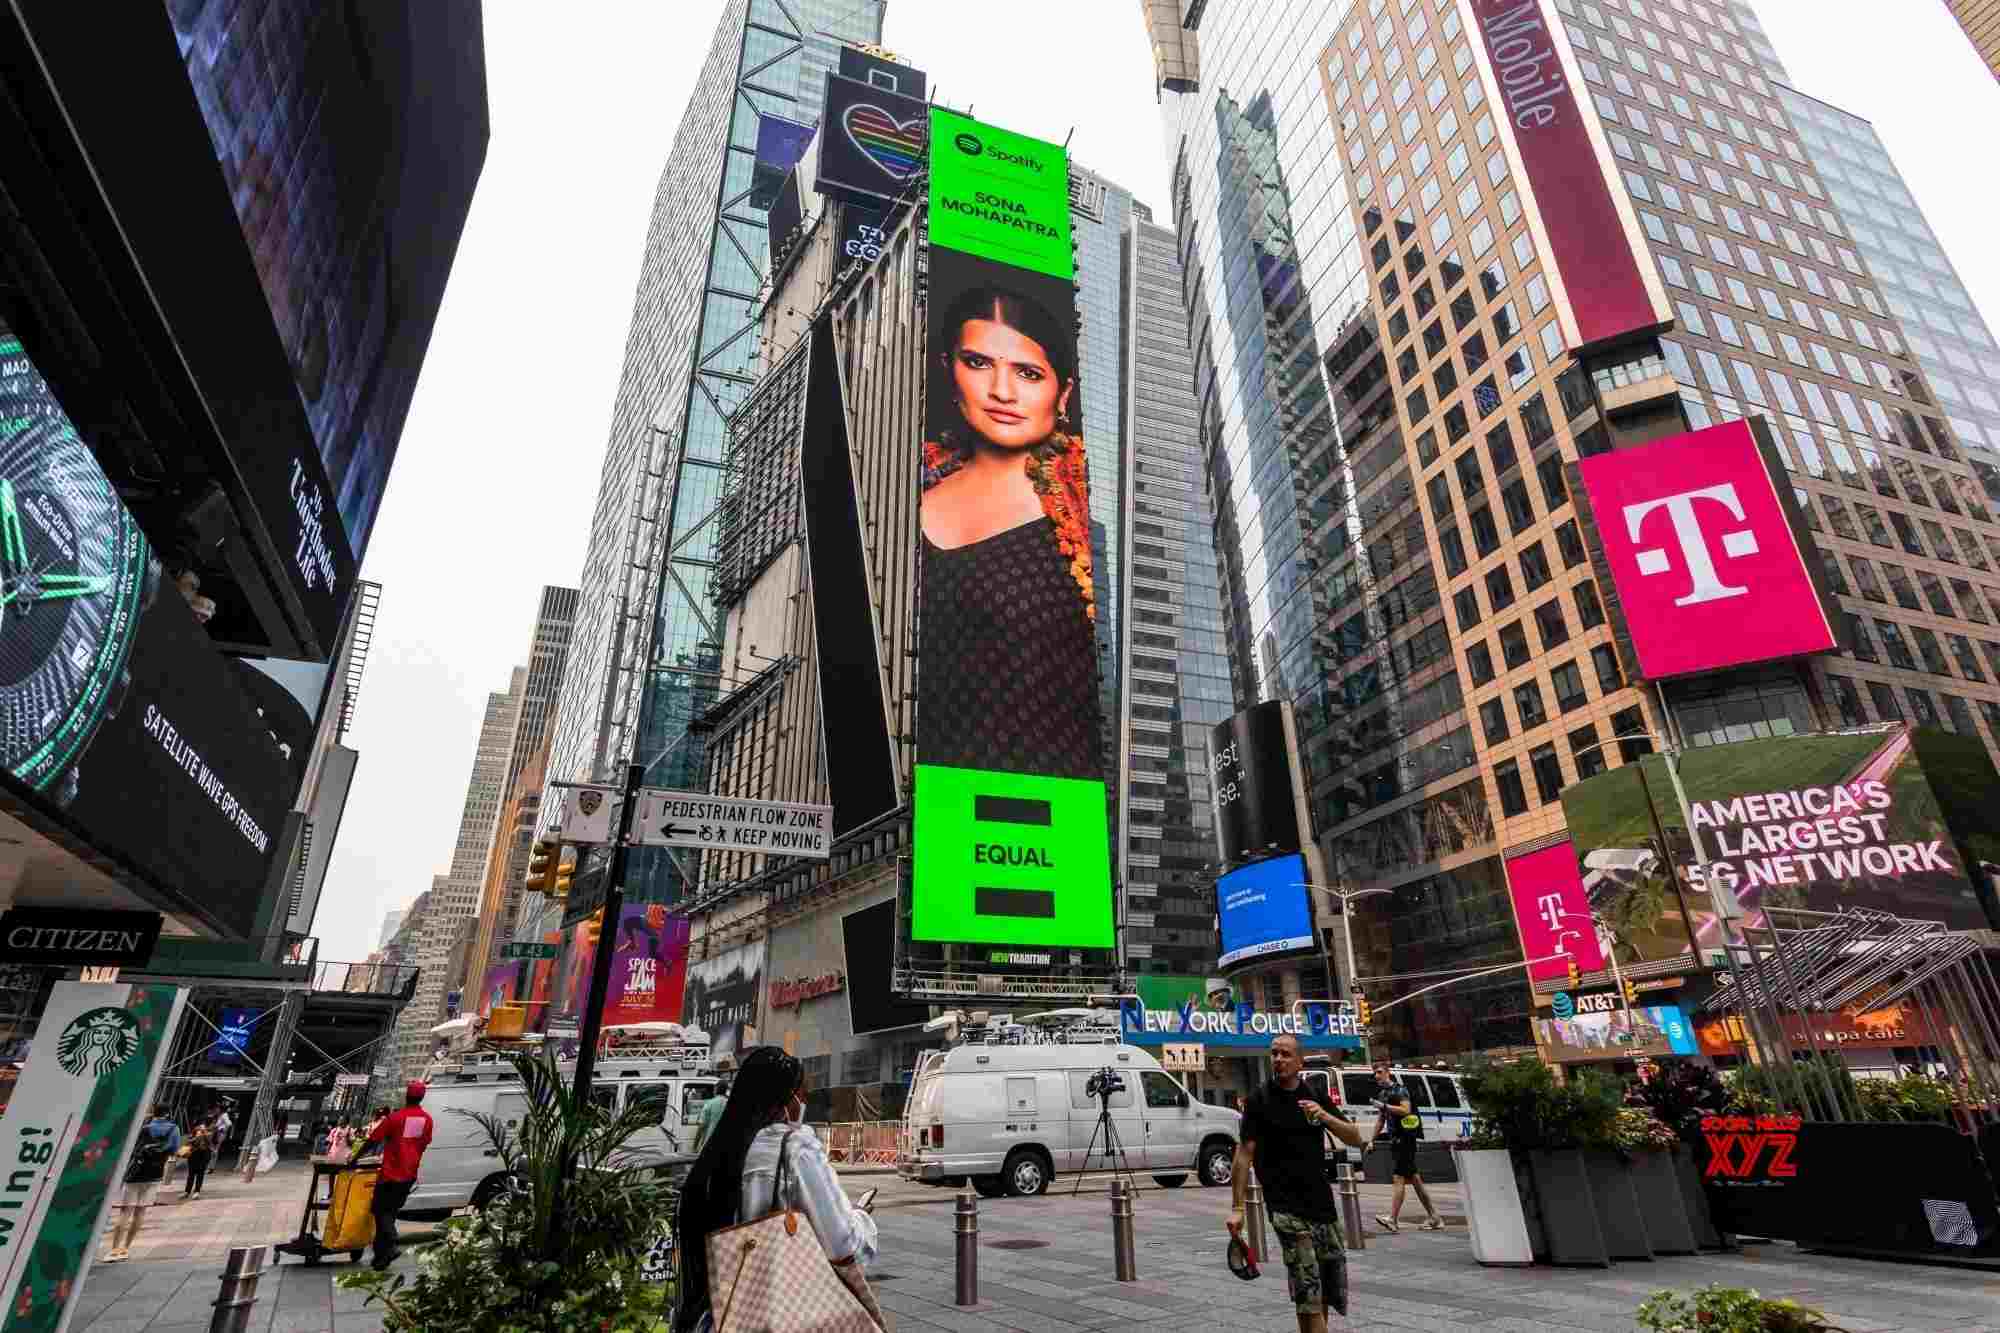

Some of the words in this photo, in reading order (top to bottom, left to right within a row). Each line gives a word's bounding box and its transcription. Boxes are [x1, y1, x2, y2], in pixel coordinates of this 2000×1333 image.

[1483, 0, 1565, 129] Mobile
[987, 144, 1043, 173] Spotify
[941, 196, 1060, 239] MOHAPATRA
[975, 191, 1027, 215] SONA
[1622, 482, 1760, 607] T
[143, 703, 201, 777] SATELLITE
[198, 764, 224, 804] WAVE
[221, 792, 239, 821] GPS
[236, 808, 268, 853] FREEDOM
[662, 800, 746, 822] PEDESTRIAN
[751, 807, 787, 825] FLOW
[789, 811, 824, 829] ZONE
[1694, 780, 1892, 829] AMERICA'S
[733, 827, 769, 844] KEEP
[772, 831, 822, 850] MOVING
[1716, 813, 1888, 858] LARGEST
[975, 843, 1054, 868] EQUAL
[1744, 840, 1953, 888] NETWORK
[7, 926, 144, 952] CITIZEN
[628, 957, 657, 973] SPACE
[624, 971, 656, 992] JAM
[1120, 1000, 1171, 1033] NEW
[1172, 999, 1233, 1033] YORK
[1235, 1001, 1304, 1035] POLICE
[1306, 1004, 1360, 1035] DEPT
[1576, 992, 1617, 1013] AT&T
